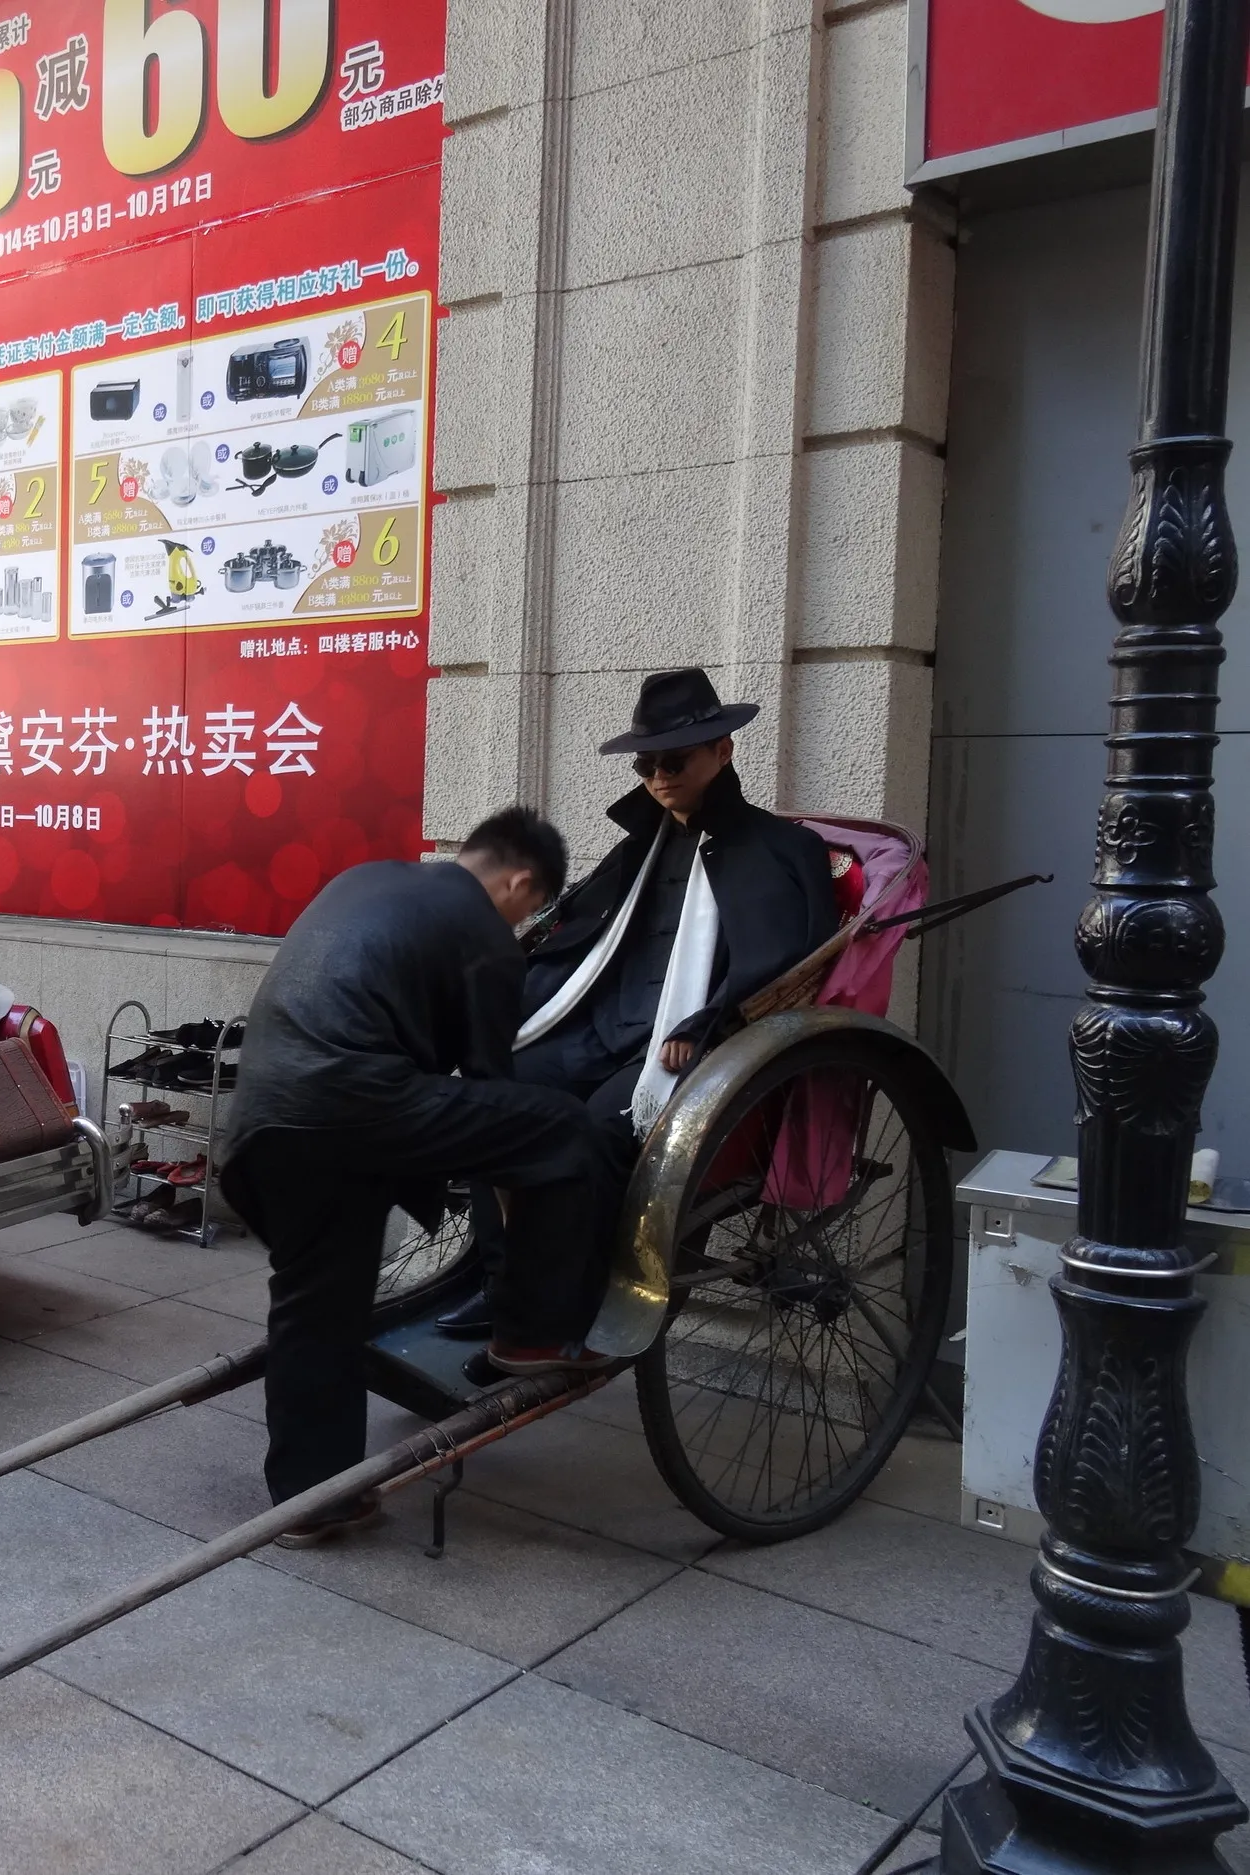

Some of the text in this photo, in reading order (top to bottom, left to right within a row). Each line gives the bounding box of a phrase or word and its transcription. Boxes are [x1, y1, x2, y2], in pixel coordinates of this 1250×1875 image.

[341, 345, 358, 366] 赠
[376, 311, 408, 361] 4
[23, 476, 45, 519] 2
[89, 461, 109, 505] 5
[122, 480, 136, 499] 赠
[336, 544, 352, 565] 赠
[373, 517, 400, 566] 6
